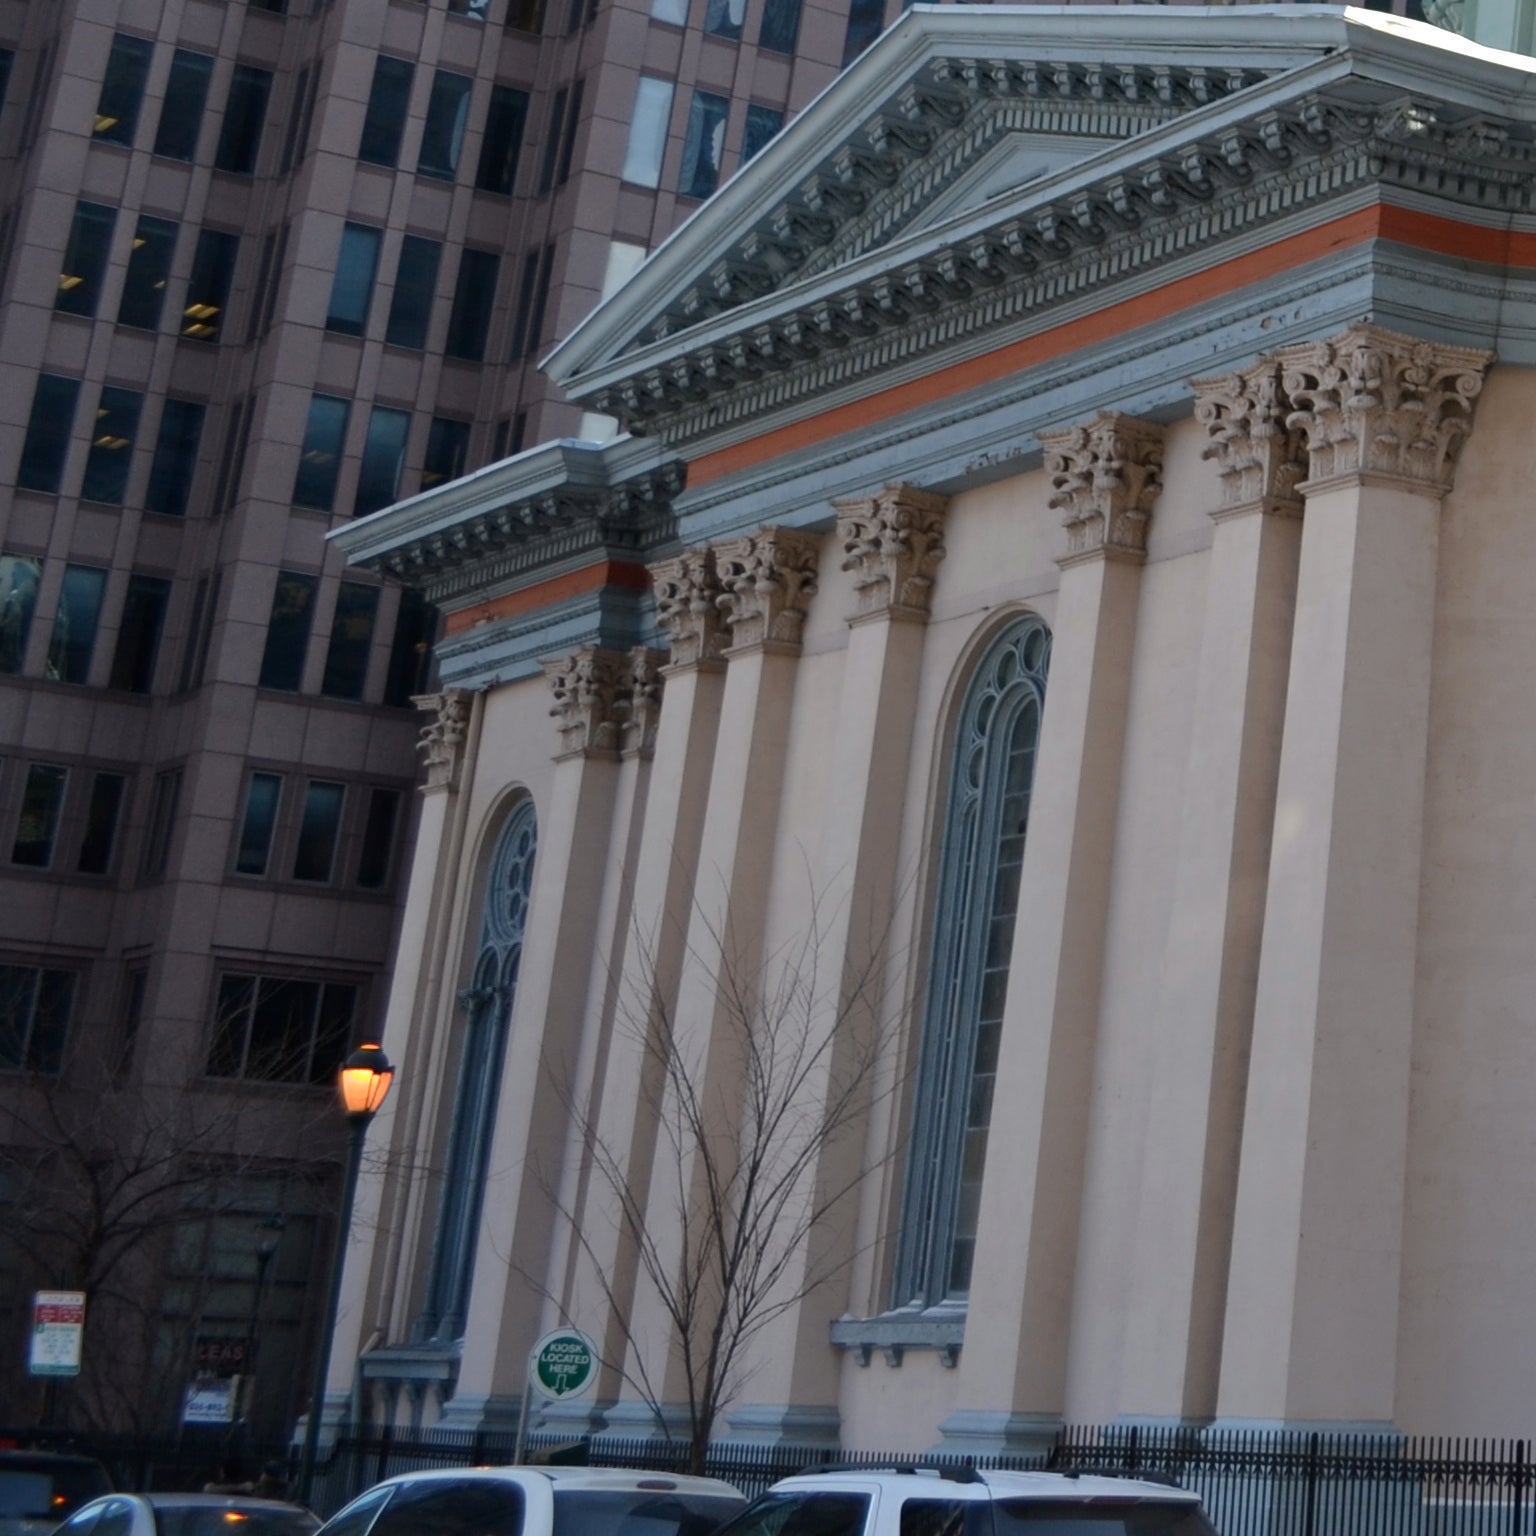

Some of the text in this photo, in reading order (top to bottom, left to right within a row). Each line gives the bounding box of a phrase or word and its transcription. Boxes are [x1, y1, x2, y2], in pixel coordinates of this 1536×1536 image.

[550, 1343, 583, 1354] KIOSK
[541, 1352, 589, 1364] LOCATED
[549, 1364, 579, 1374] HERE
